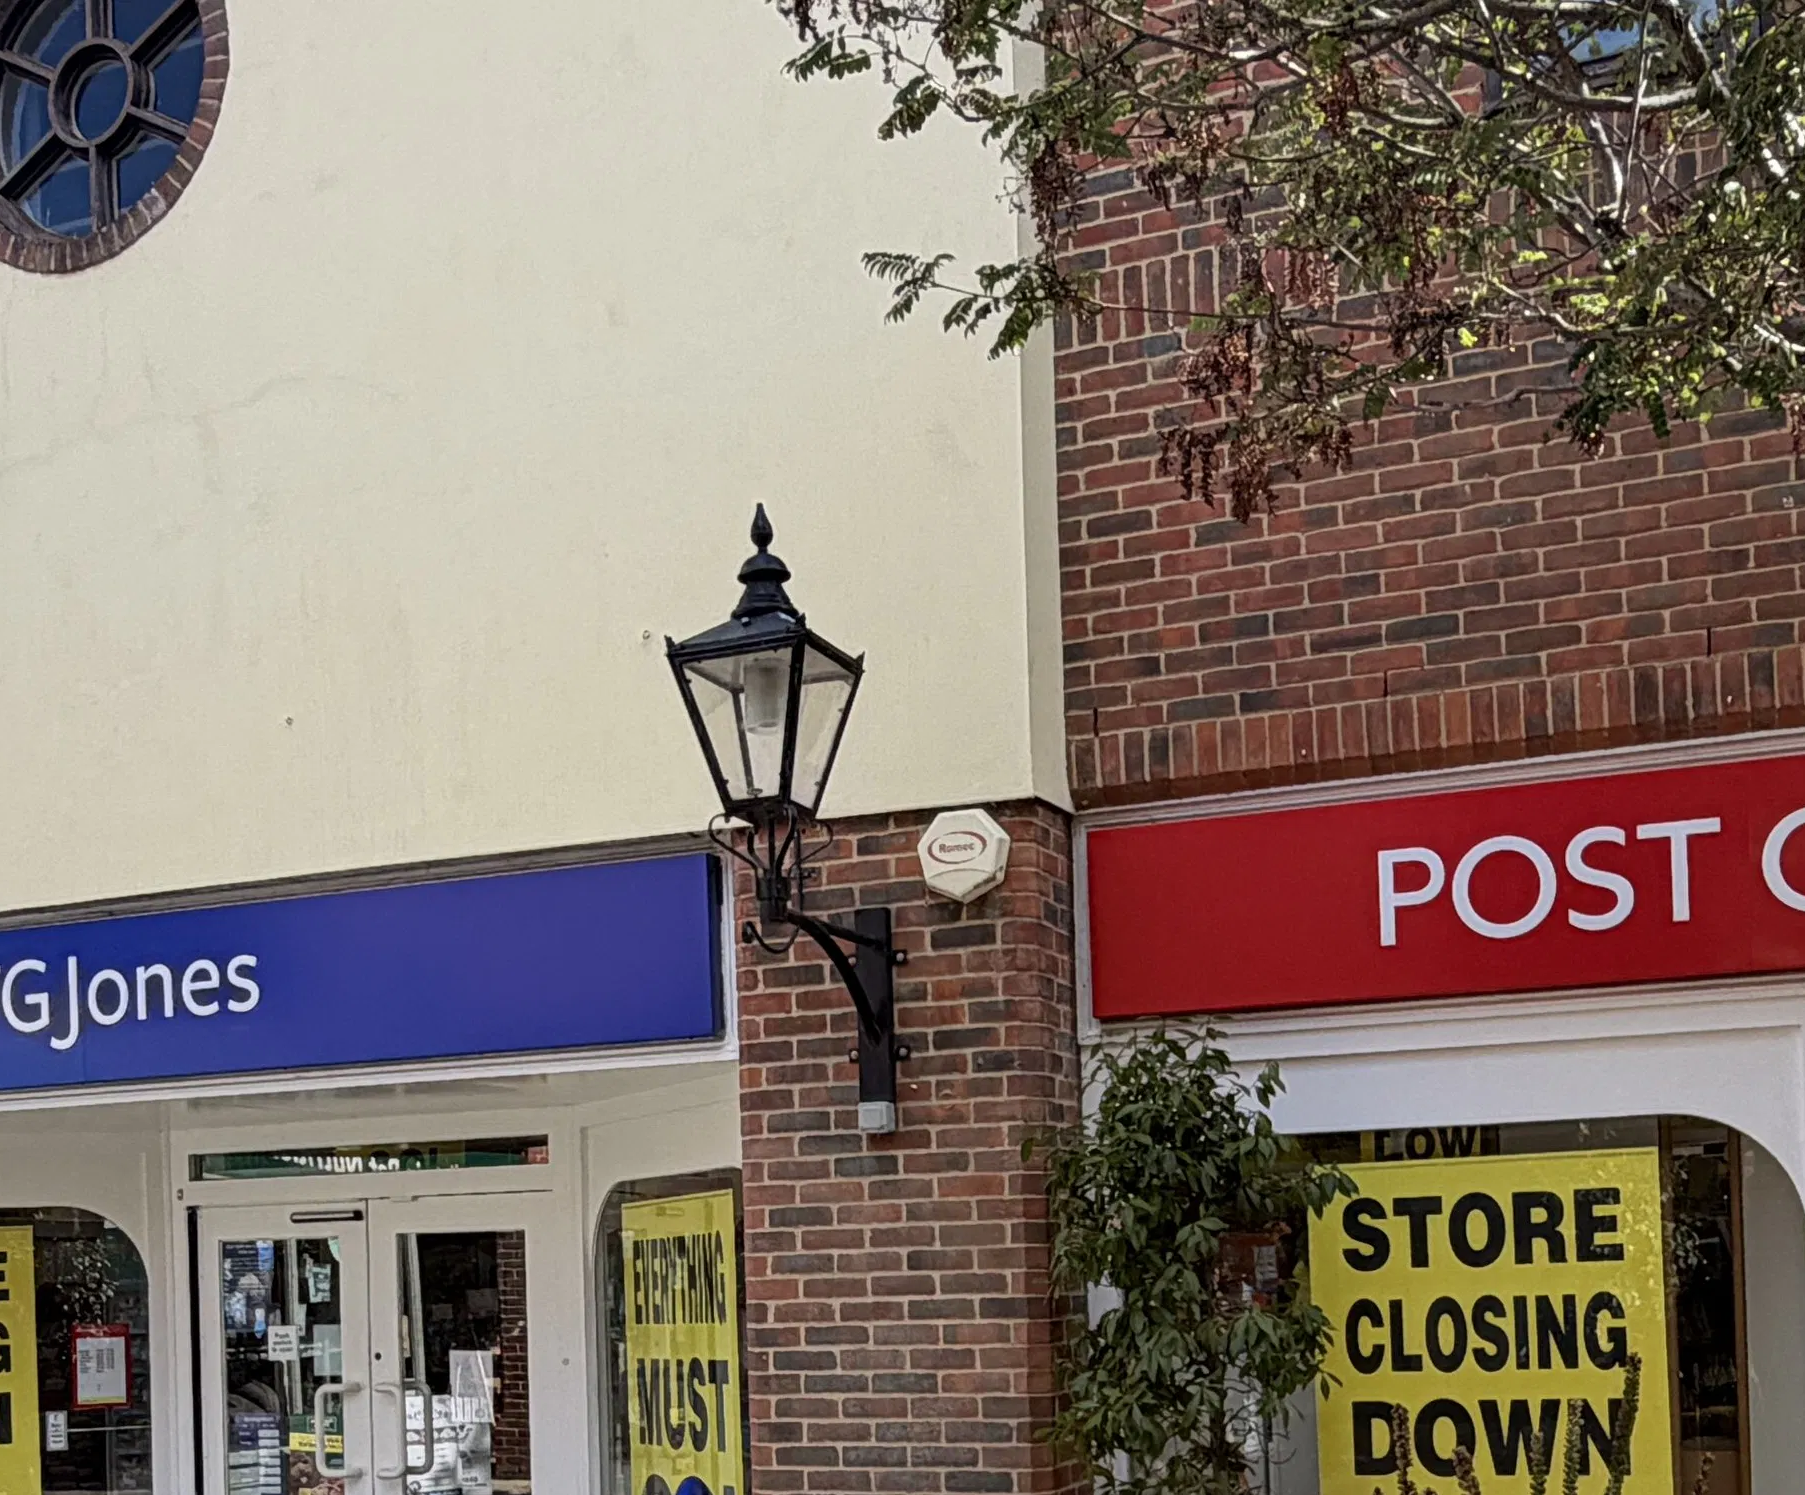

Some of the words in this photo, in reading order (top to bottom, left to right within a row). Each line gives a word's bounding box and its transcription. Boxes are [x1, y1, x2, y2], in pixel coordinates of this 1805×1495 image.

[1378, 816, 1721, 946] POST
[1342, 1187, 1625, 1272] STORE
[632, 1230, 727, 1325] EVERYTHING
[1345, 1292, 1628, 1374] CLOSING
[636, 1356, 730, 1454] MUST
[1352, 1398, 1632, 1477] DOWN
